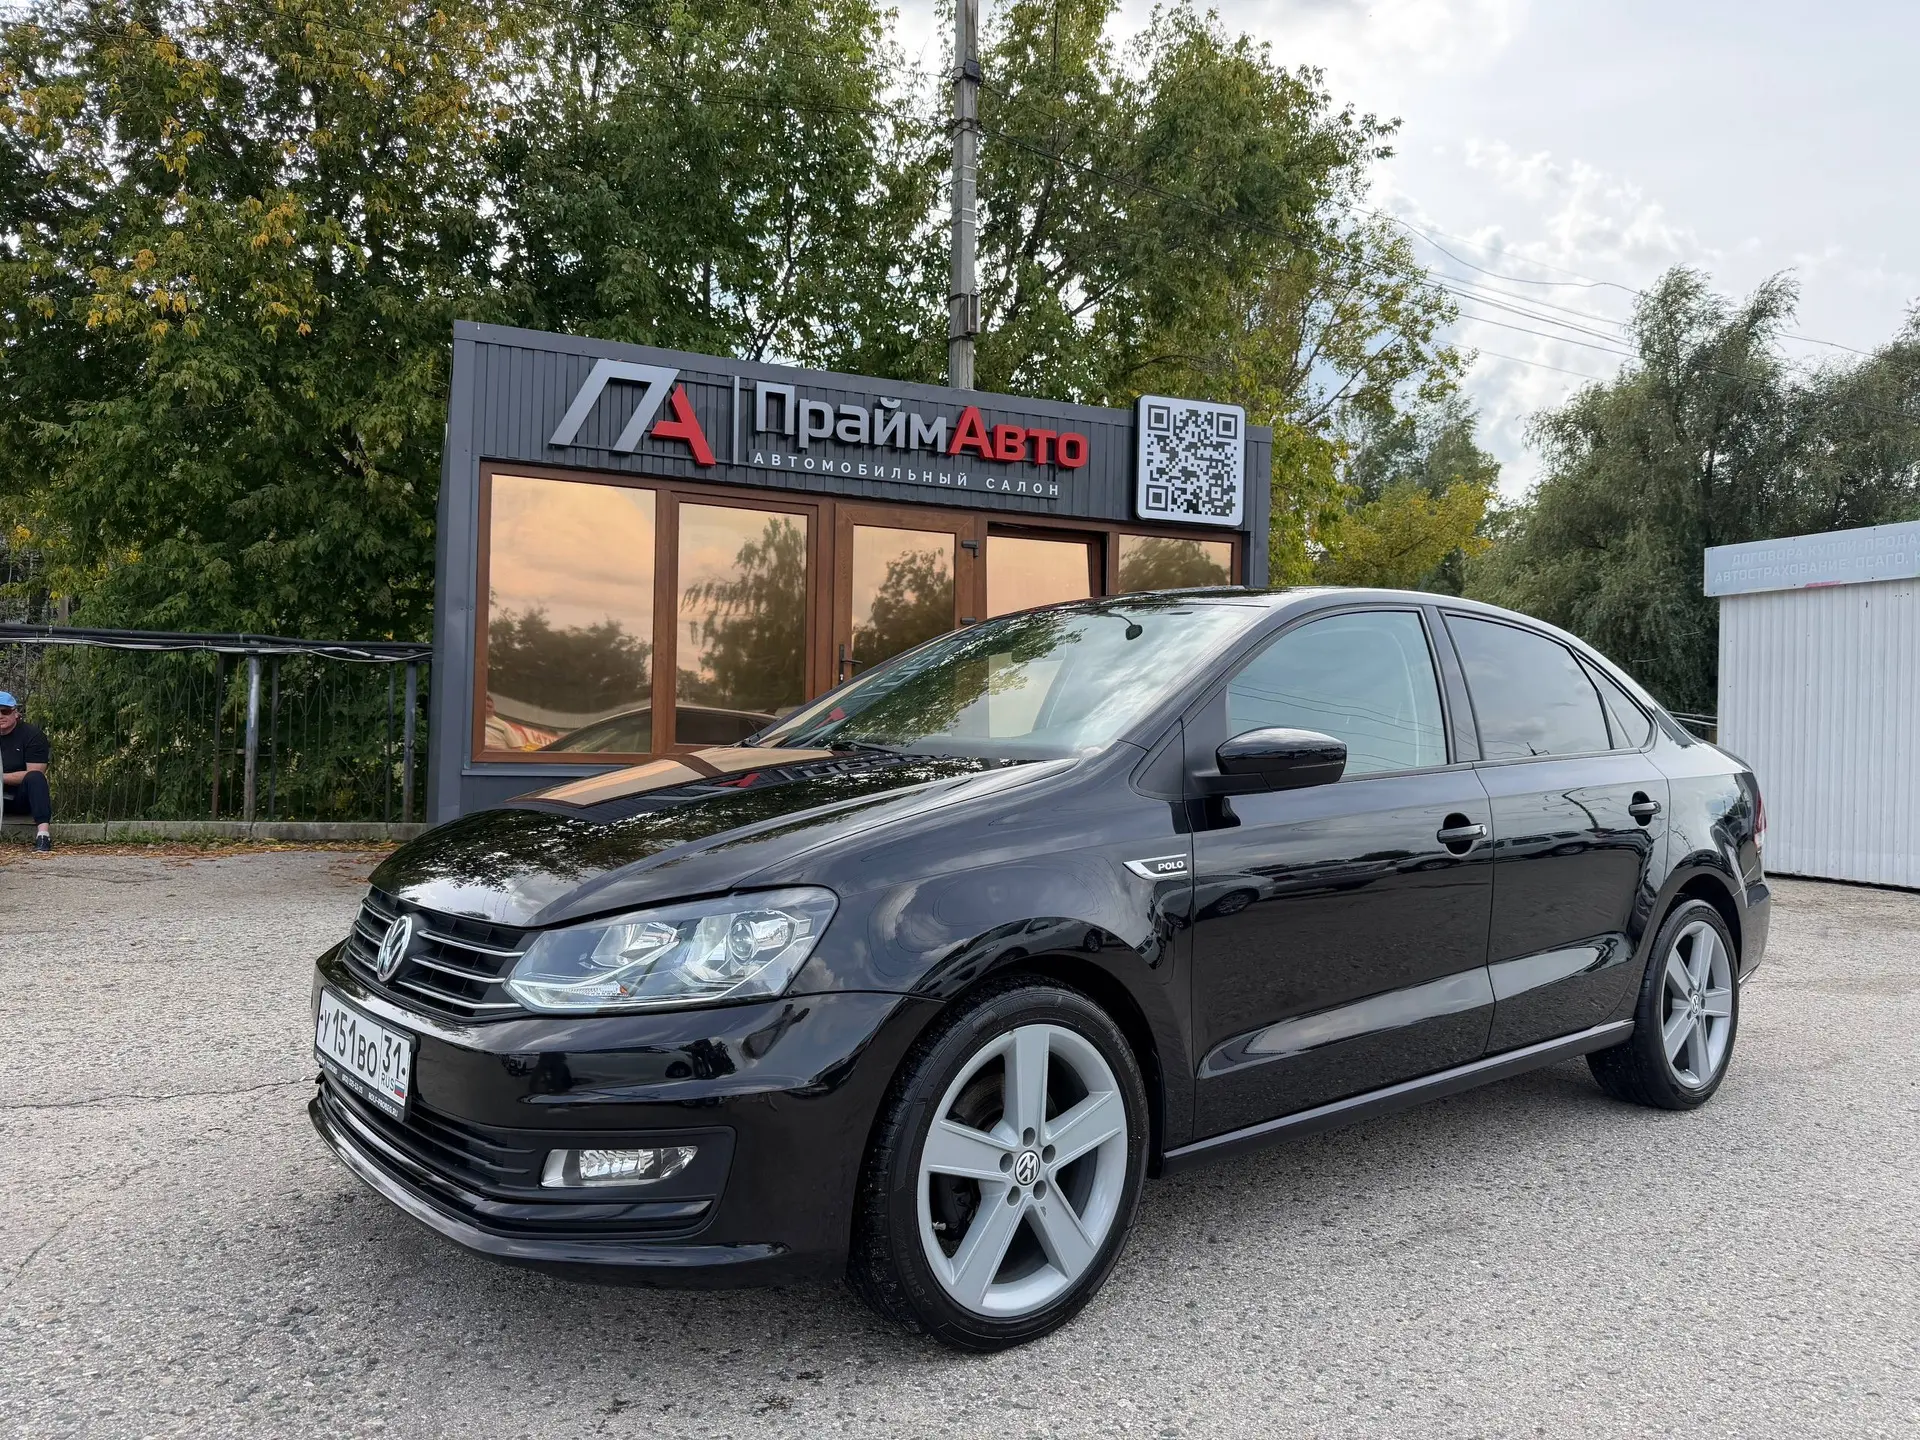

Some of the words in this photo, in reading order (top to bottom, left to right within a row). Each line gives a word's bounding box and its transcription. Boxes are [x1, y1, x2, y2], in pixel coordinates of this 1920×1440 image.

[754, 452, 967, 486] АВТОМОБИЛЬНЫЙ
[986, 478, 1059, 495] САЛОН
[1731, 547, 1803, 567] ДОГОВОРА
[1808, 533, 1920, 556] КУПЛИ-ПРОДА
[1157, 860, 1184, 871] POLO
[382, 1034, 402, 1080] 31
[380, 1073, 395, 1092] RUS
